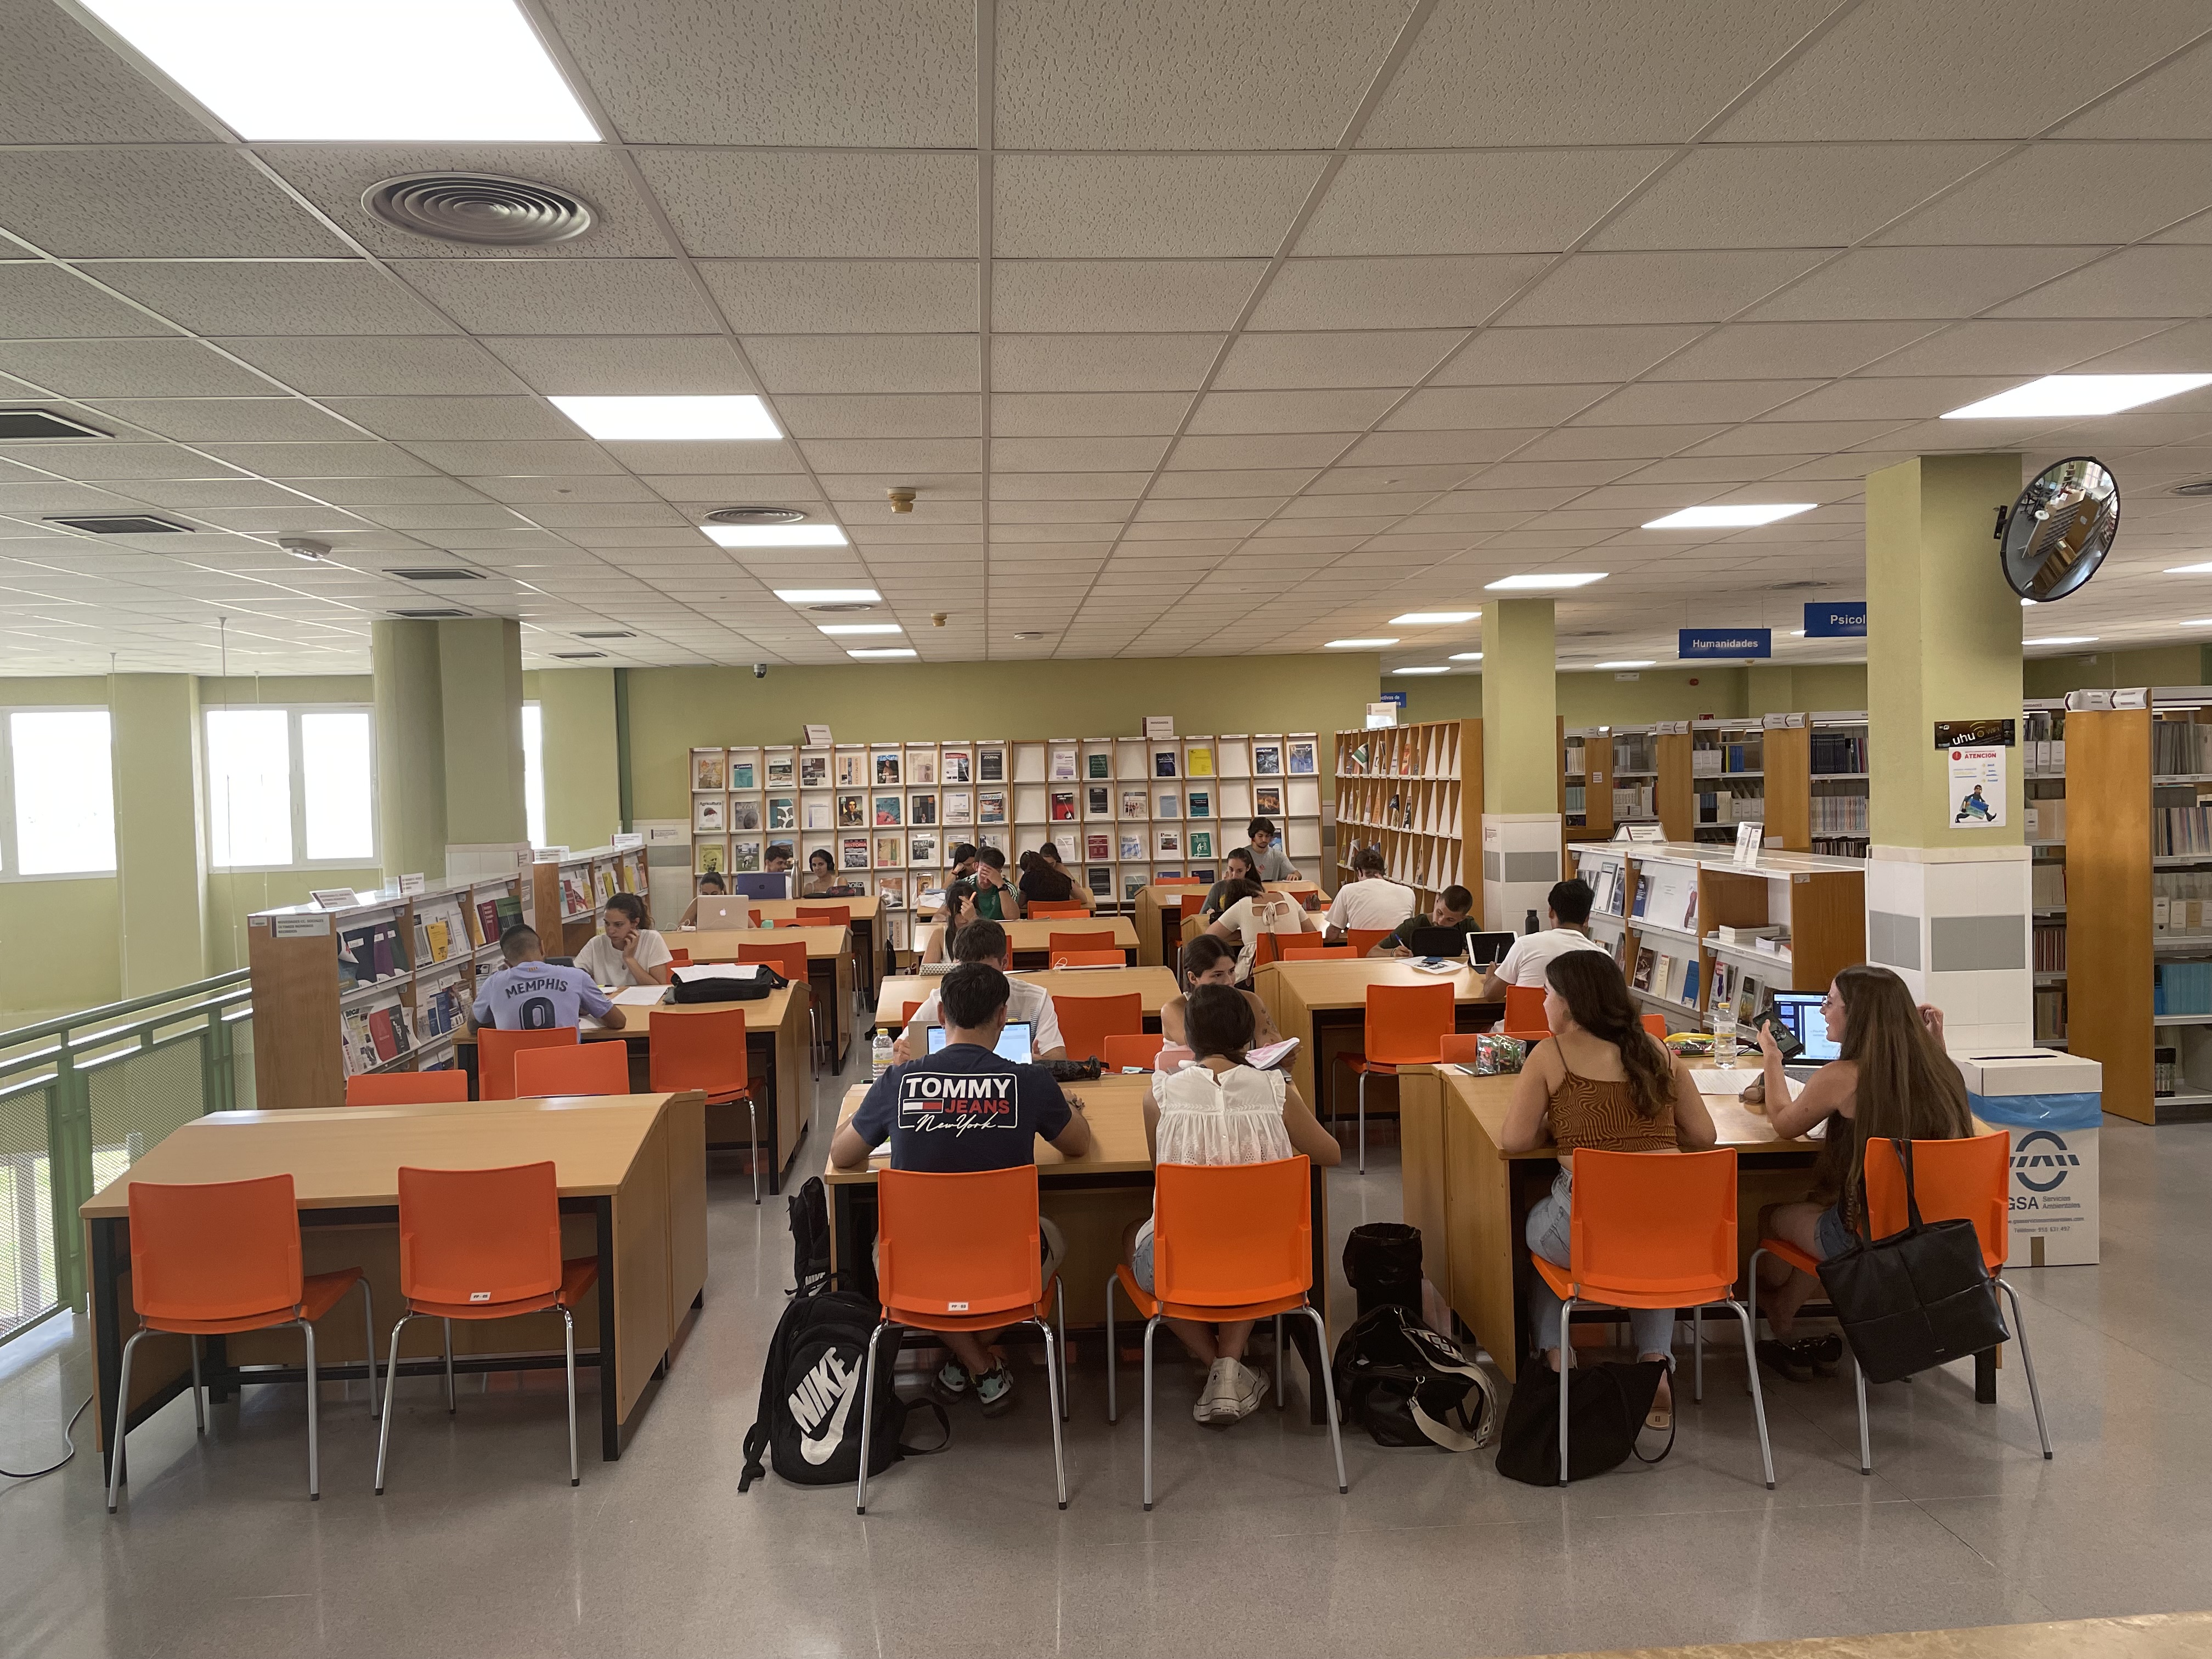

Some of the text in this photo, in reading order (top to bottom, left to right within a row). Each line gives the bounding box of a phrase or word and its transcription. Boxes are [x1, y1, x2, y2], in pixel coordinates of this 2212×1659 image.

[1830, 614, 1866, 625] Psicol
[1692, 639, 1758, 648] Humanidades
[1952, 732, 1976, 745] uhu
[505, 978, 568, 999] MEMPHIS
[906, 1077, 1011, 1098] TOMMY
[945, 1099, 1011, 1114] JEANS
[788, 1347, 854, 1434] NIKE
